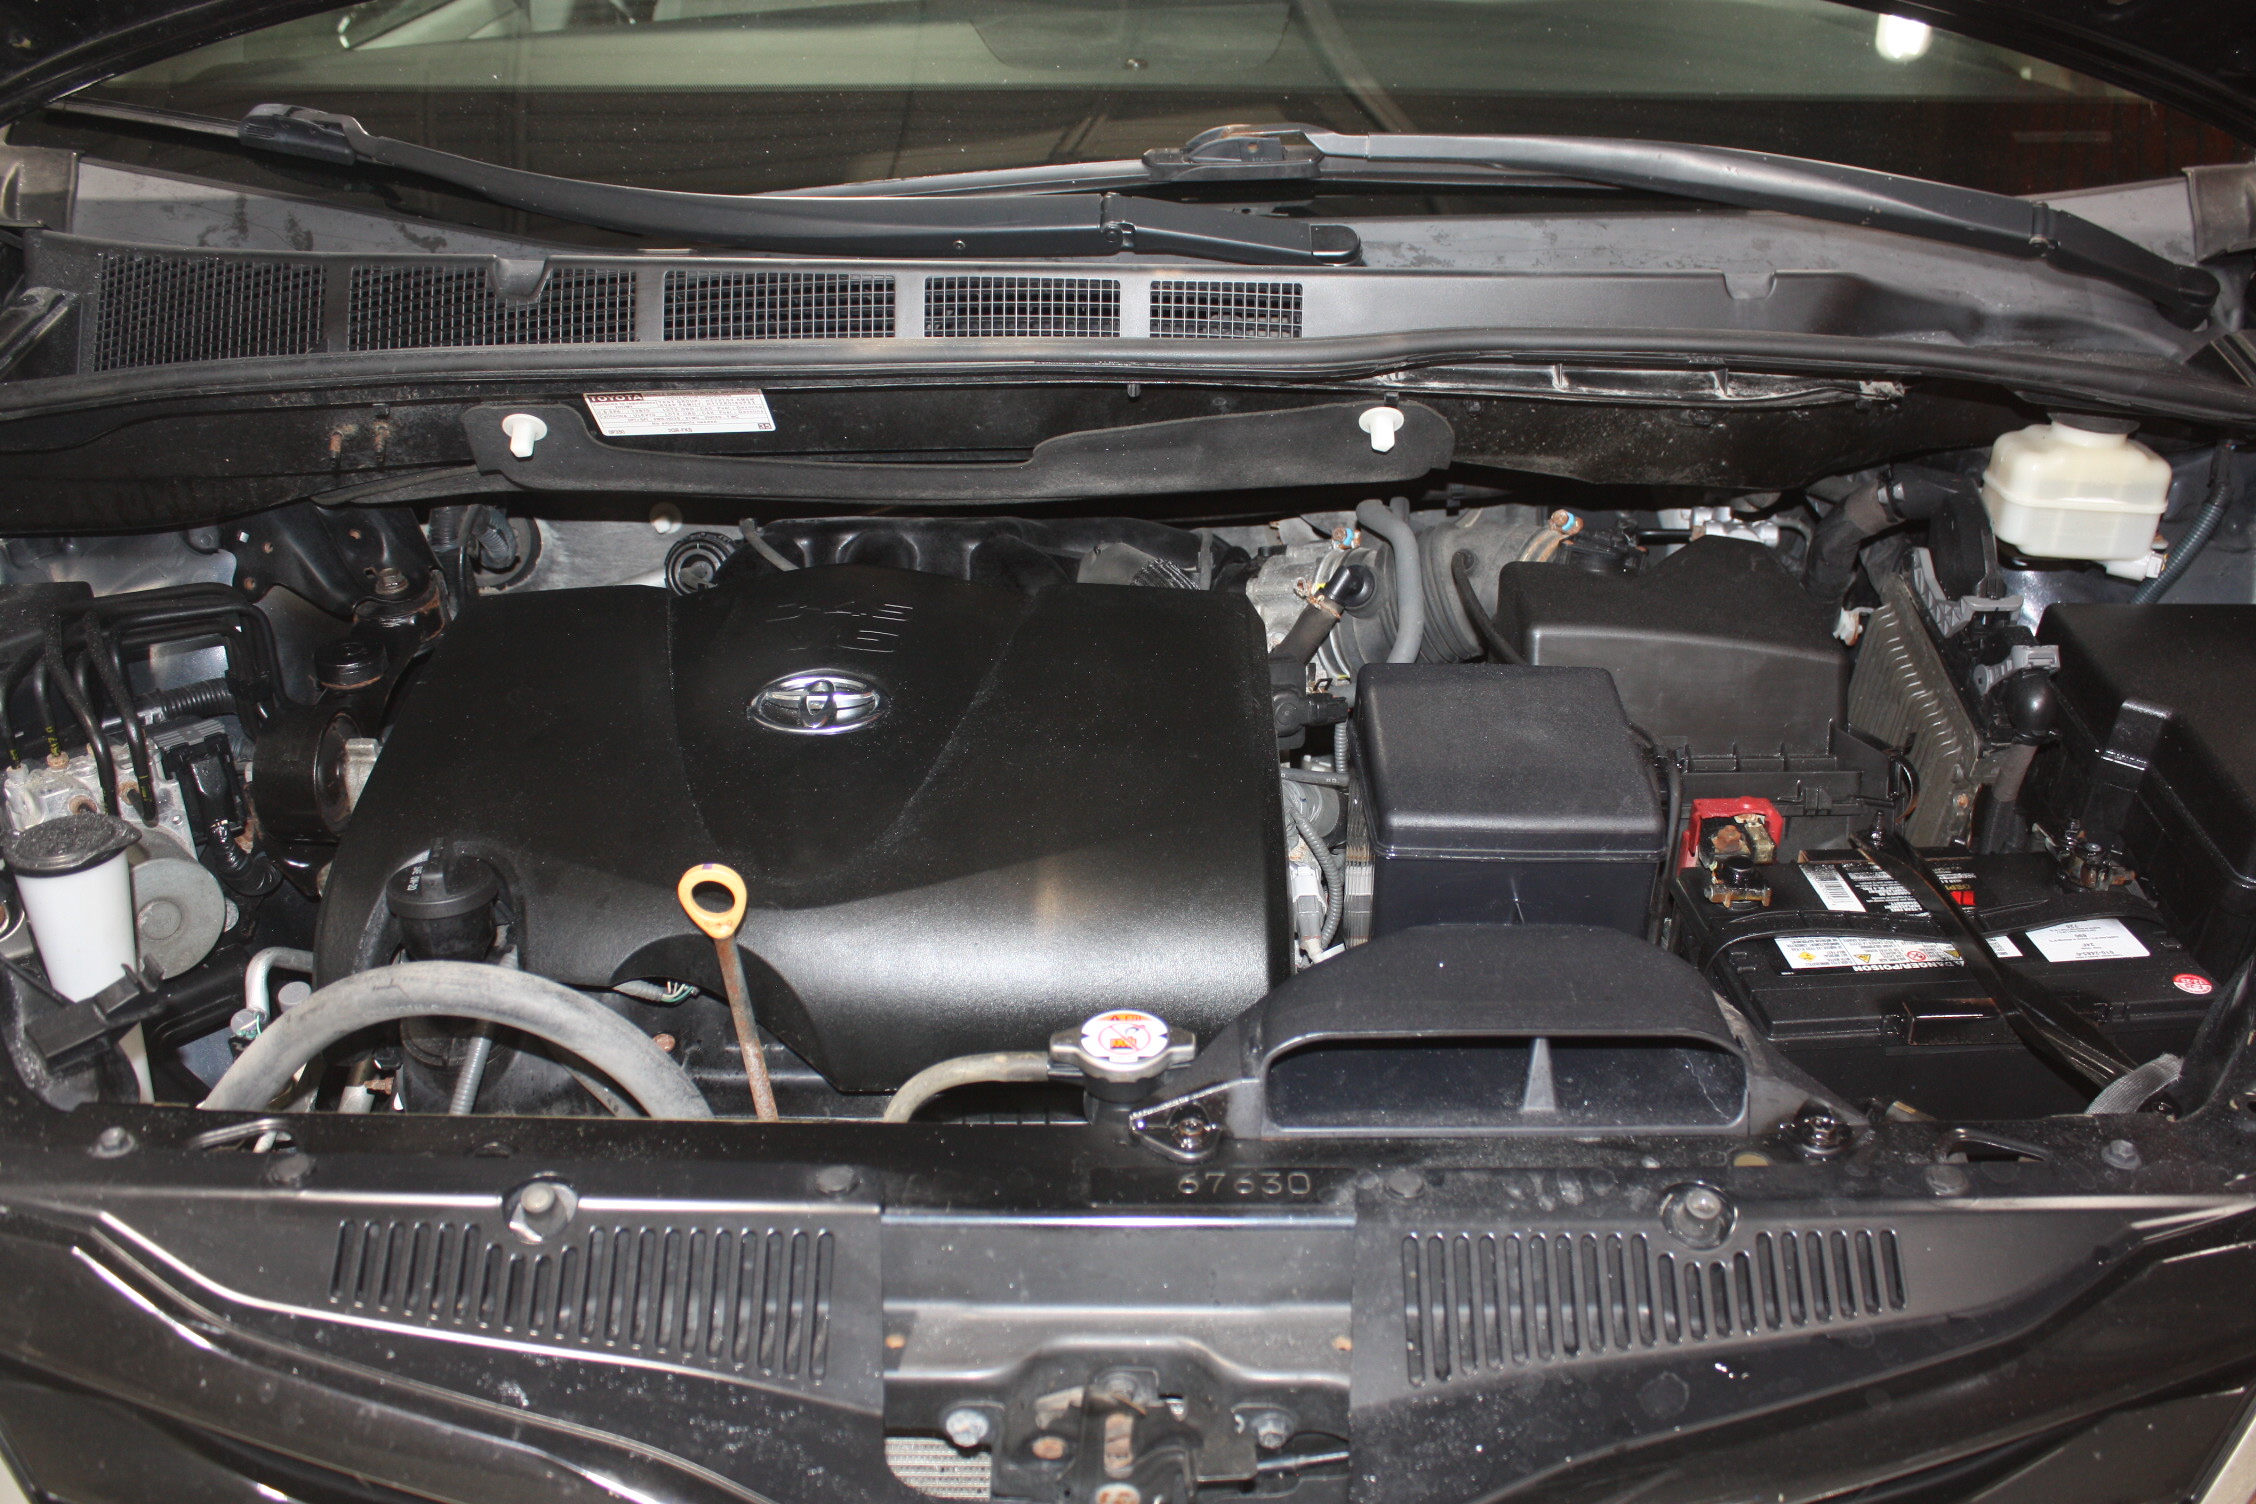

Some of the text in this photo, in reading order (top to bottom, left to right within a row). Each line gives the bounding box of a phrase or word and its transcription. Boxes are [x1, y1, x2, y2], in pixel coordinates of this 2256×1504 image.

[588, 394, 643, 402] TOYOTA
[1852, 961, 1955, 972] DANGER/POISON
[1177, 1171, 1311, 1195] 67630
